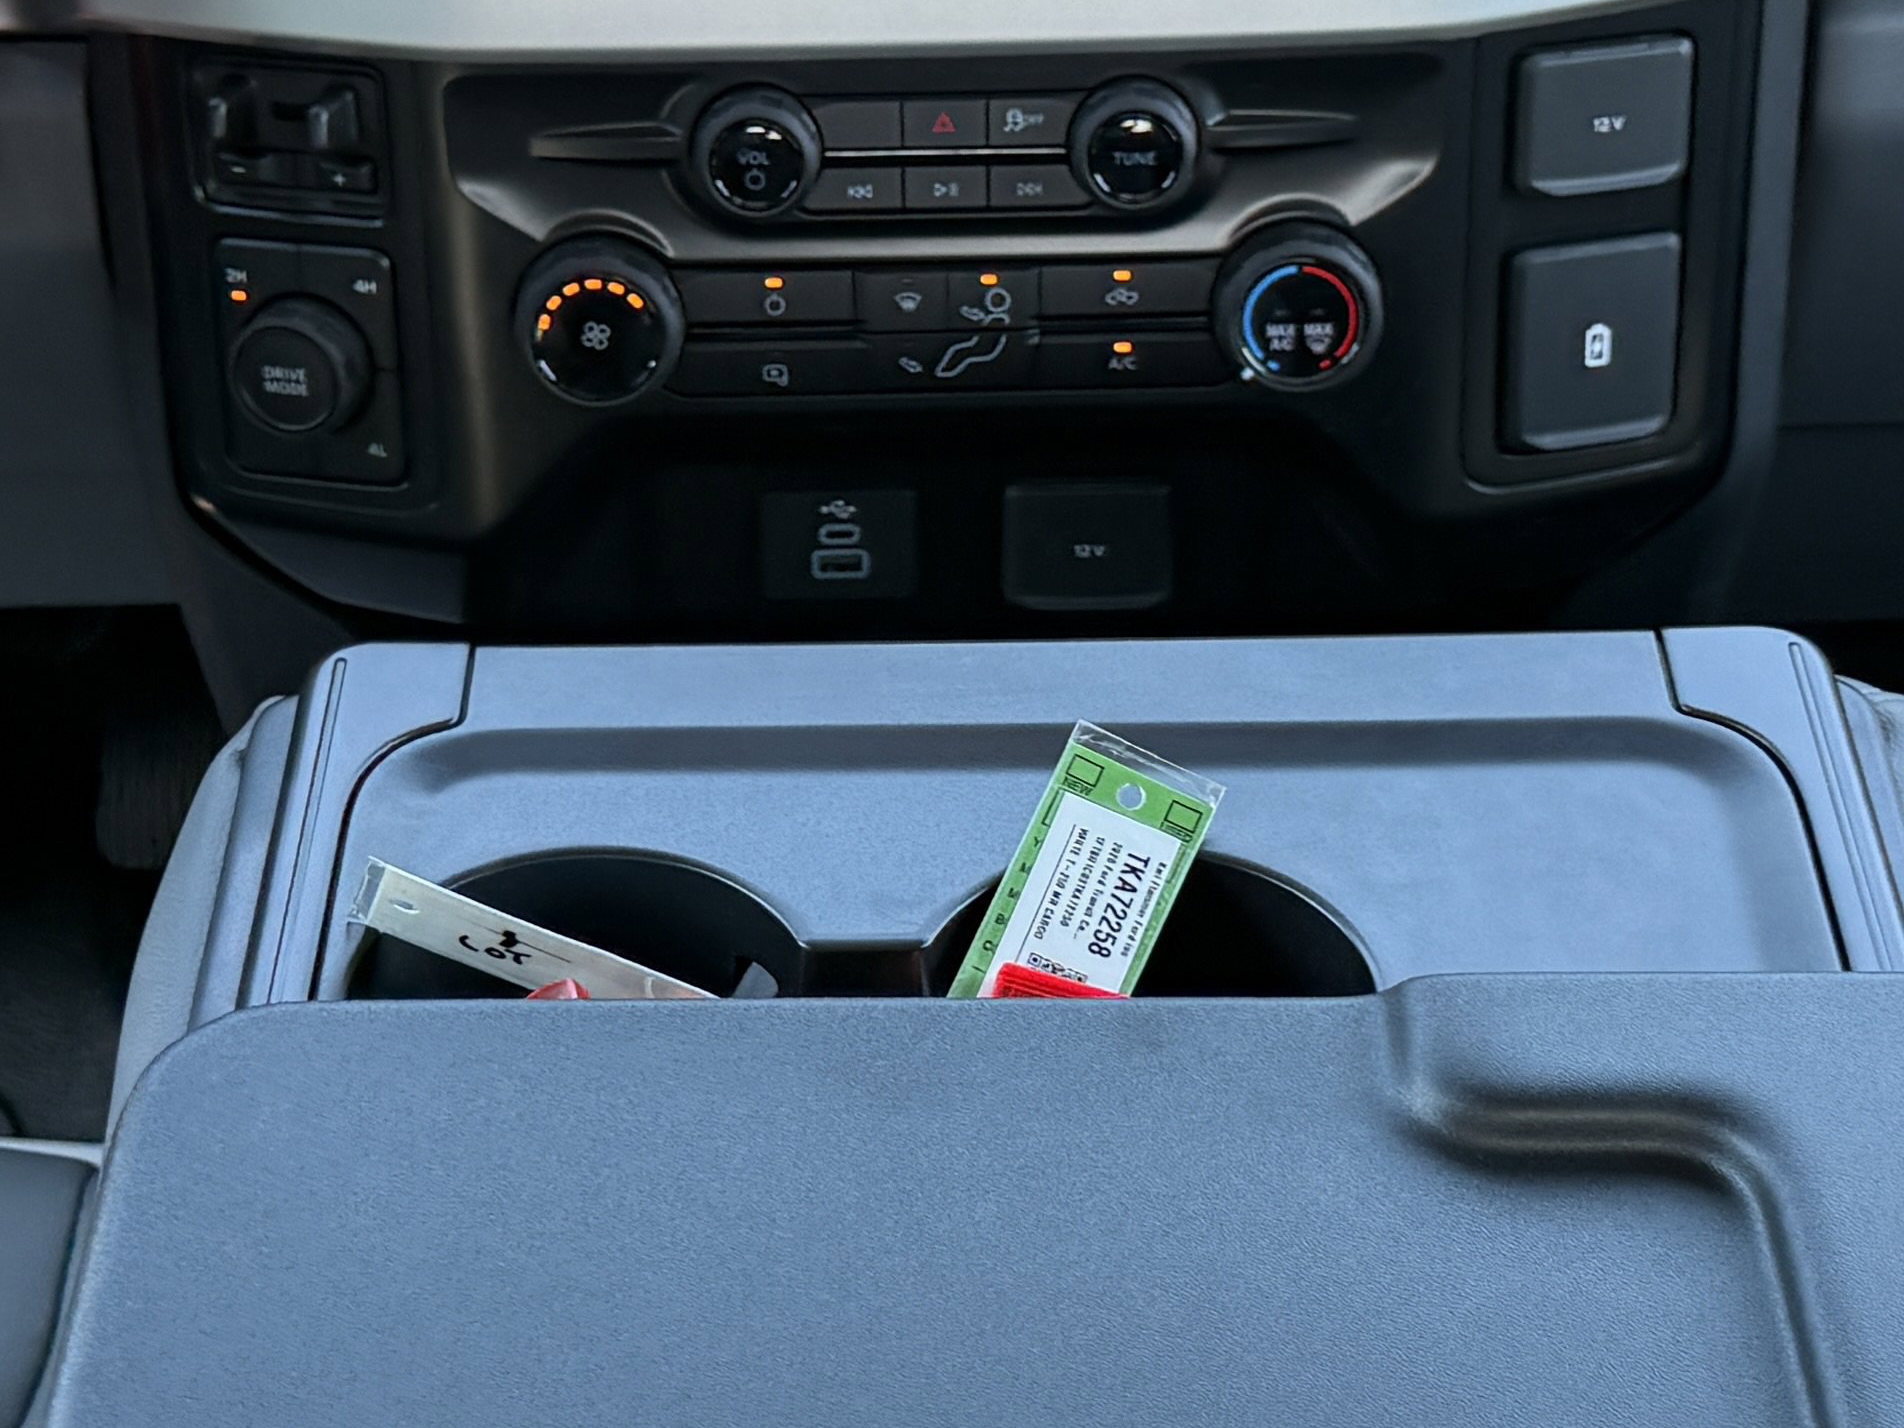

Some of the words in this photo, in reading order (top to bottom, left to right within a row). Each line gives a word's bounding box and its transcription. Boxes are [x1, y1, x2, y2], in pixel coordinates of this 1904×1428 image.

[737, 151, 769, 167] VOL
[1113, 151, 1158, 166] TUNE
[1108, 356, 1138, 371] A/C
[261, 365, 307, 382] DRIVE
[263, 381, 309, 397] MODE
[1062, 777, 1094, 797] NEW
[1083, 851, 1152, 958] TKA72258
